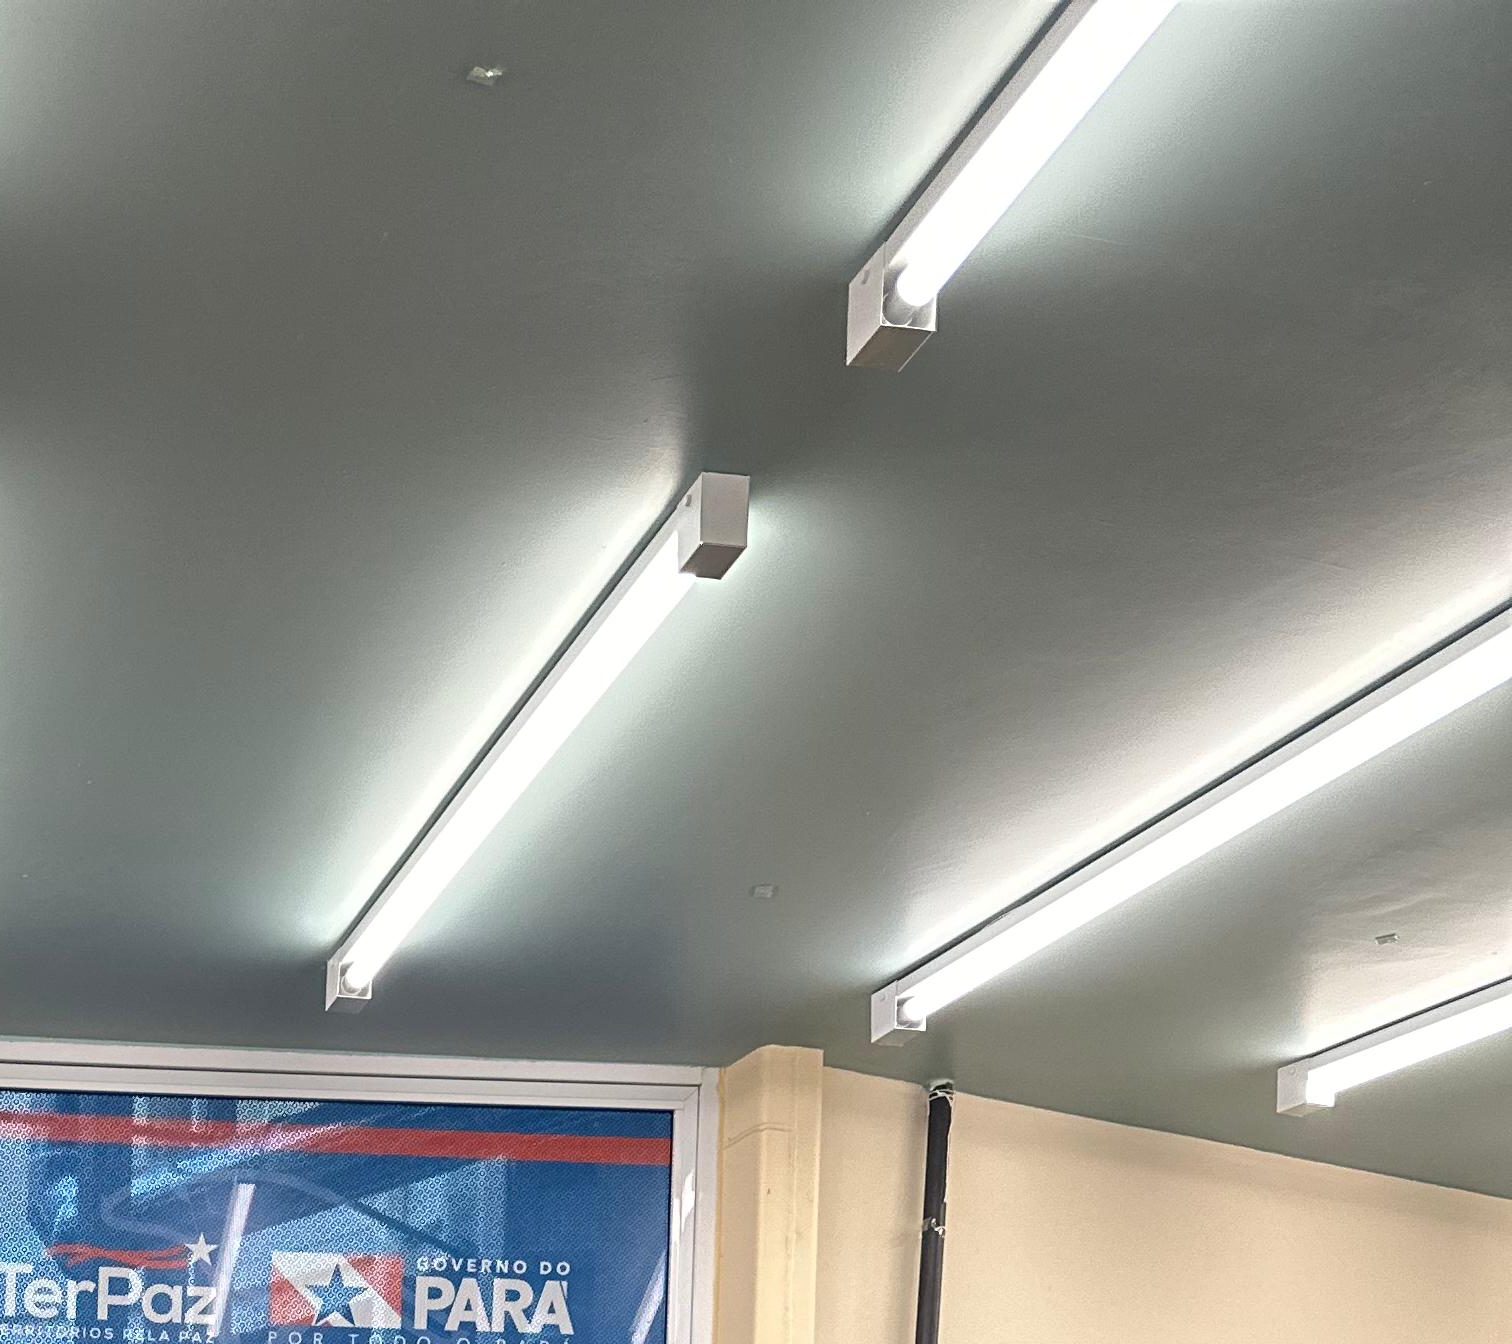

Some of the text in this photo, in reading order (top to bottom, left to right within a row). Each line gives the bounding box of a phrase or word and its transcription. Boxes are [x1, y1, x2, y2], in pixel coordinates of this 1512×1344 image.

[416, 1256, 571, 1276] GOVERNO DO
[178, 1329, 216, 1344] PAZ
